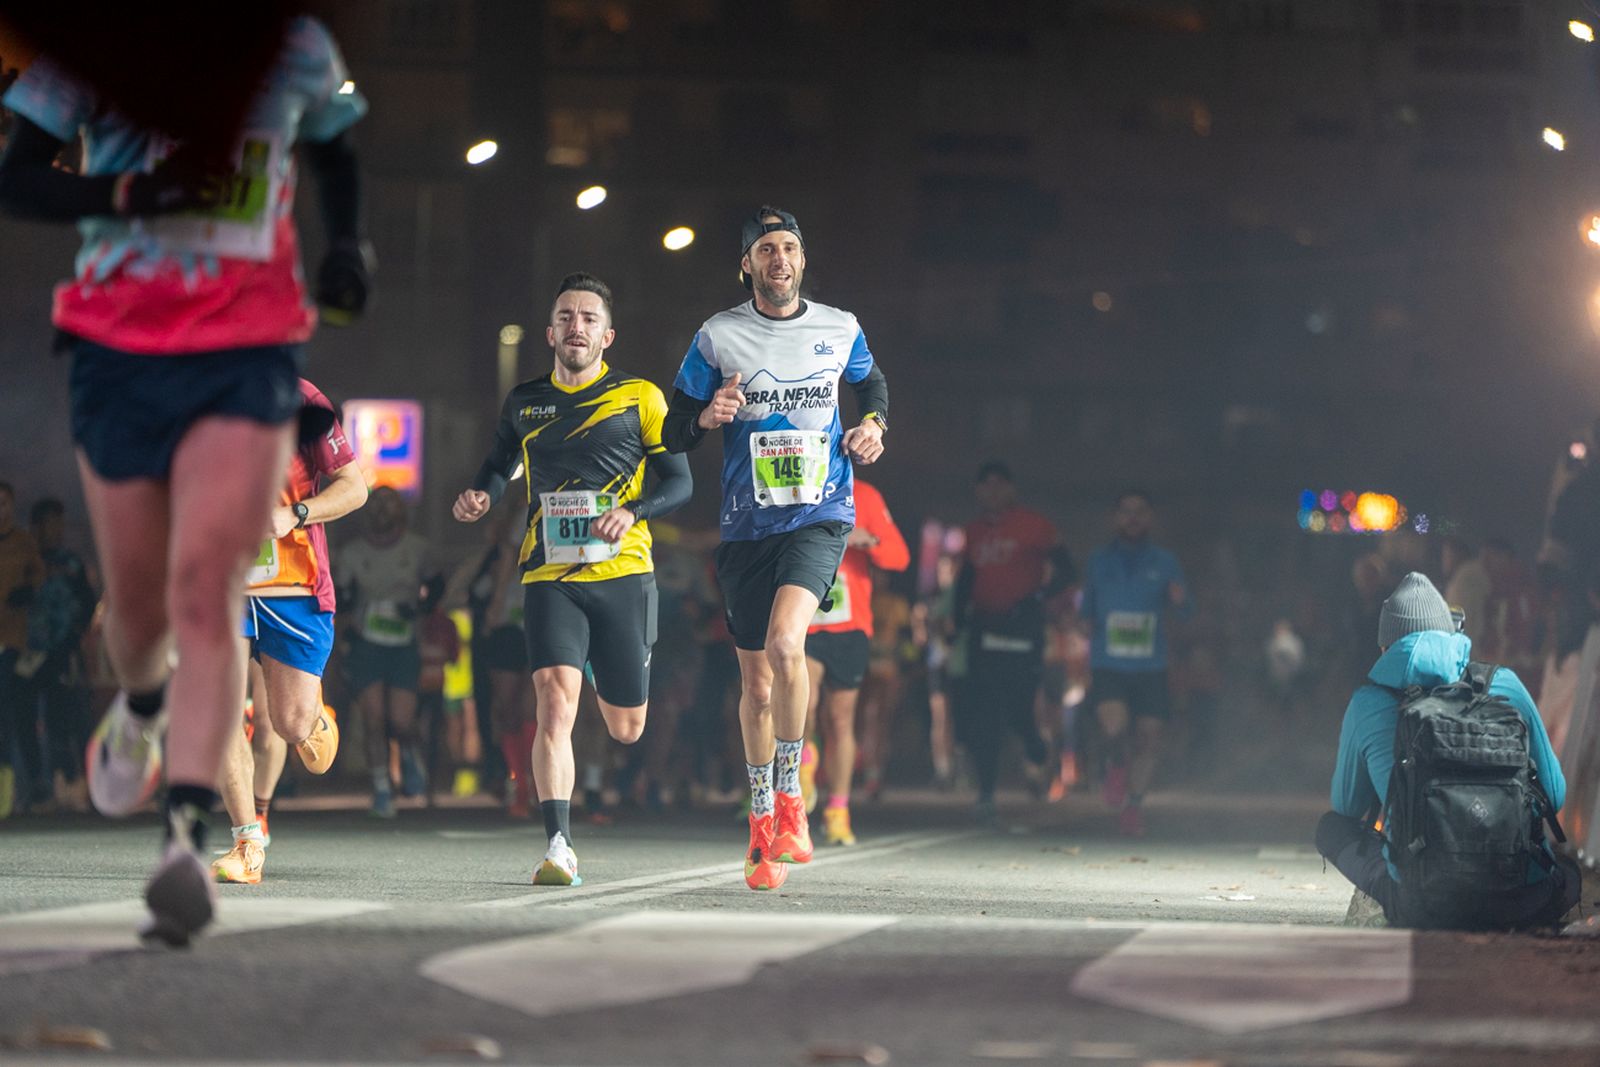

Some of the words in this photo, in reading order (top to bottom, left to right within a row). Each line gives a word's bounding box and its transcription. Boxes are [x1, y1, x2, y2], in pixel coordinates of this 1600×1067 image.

[745, 390, 780, 405] ERRA
[520, 405, 556, 416] FOCUS
[769, 401, 798, 412] TRAIL
[768, 438, 792, 447] NOCHE
[794, 438, 804, 446] DE
[760, 448, 777, 457] SAN
[558, 498, 579, 507] NOCHE
[580, 498, 589, 508] DE
[551, 507, 564, 516] SAN
[559, 517, 599, 539] 817
